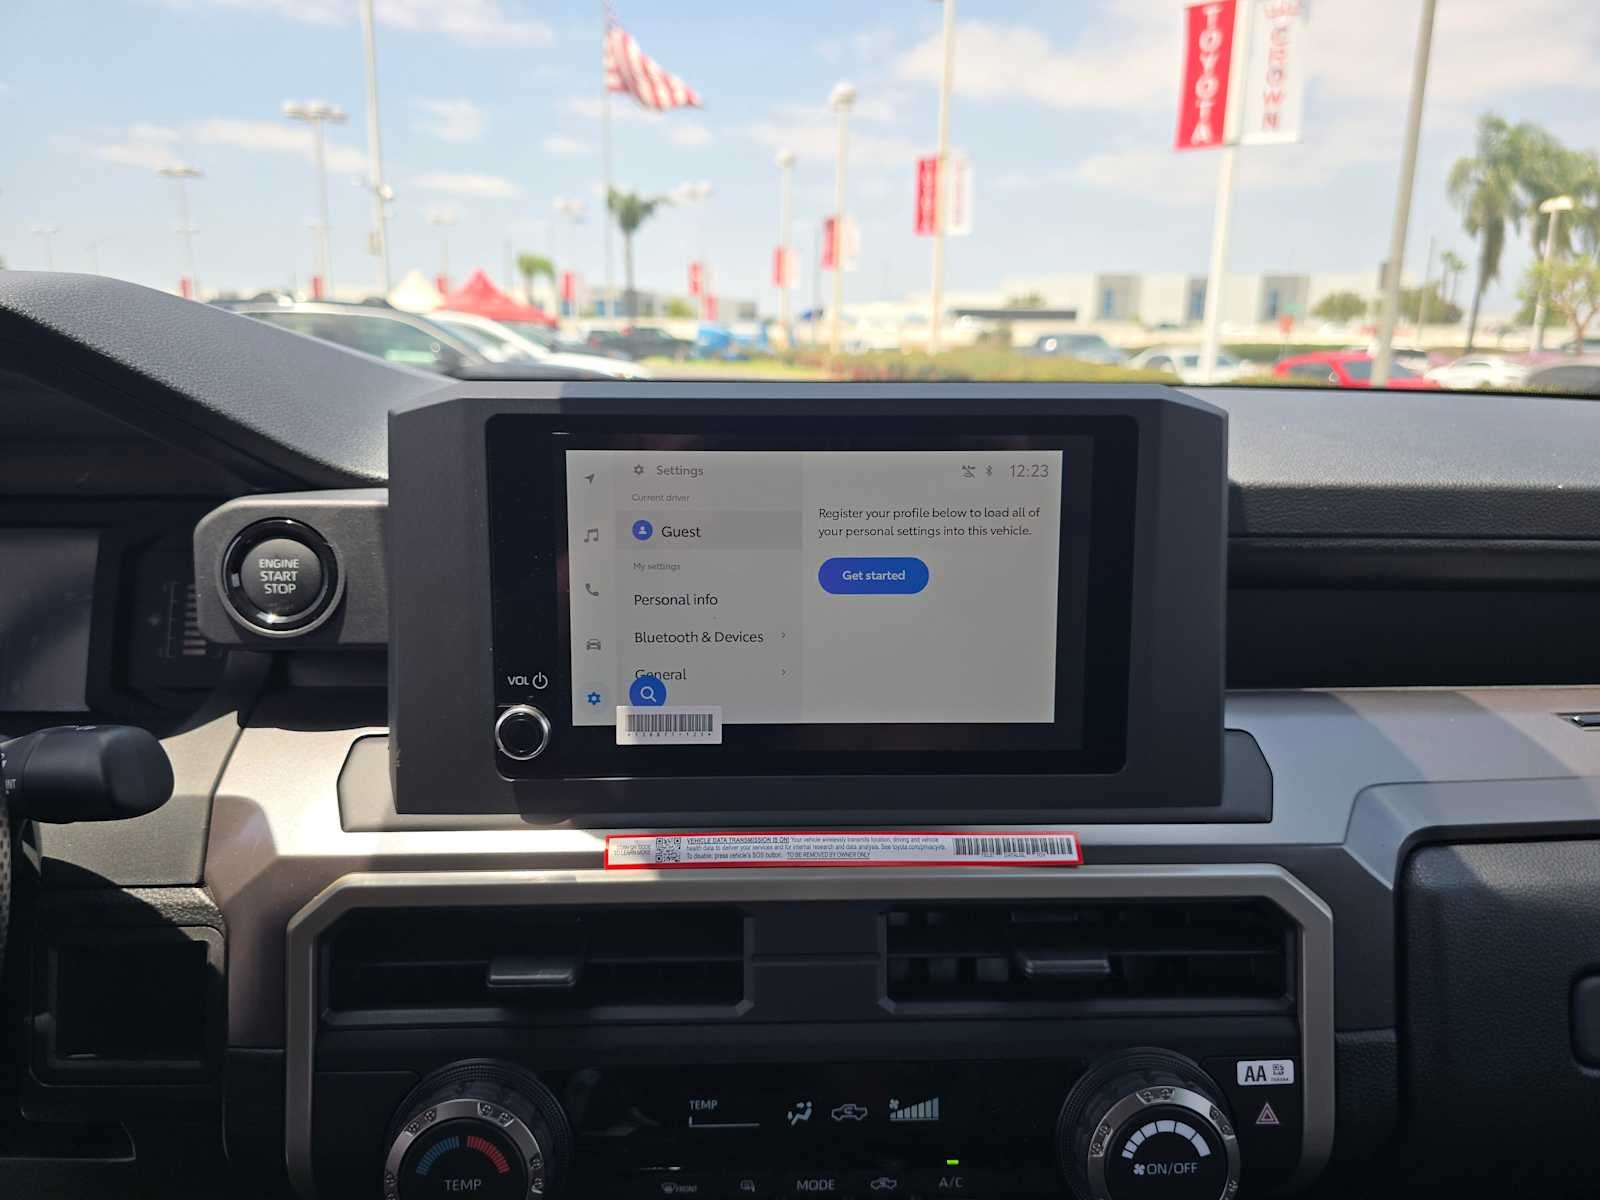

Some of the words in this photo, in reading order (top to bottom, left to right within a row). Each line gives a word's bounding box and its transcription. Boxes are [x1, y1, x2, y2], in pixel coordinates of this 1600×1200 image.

[1190, 5, 1222, 144] TOYOTA
[656, 464, 704, 478] Settings
[1009, 464, 1049, 478] 12:23
[632, 493, 664, 502] Current
[666, 493, 690, 502] driver
[819, 507, 863, 519] Register
[866, 509, 891, 519] your
[893, 507, 930, 519] profile
[932, 507, 967, 518] below
[970, 508, 982, 518] to
[984, 507, 1010, 518] load
[1012, 507, 1026, 518] all
[1028, 507, 1041, 518] of
[661, 525, 702, 539] Guest
[818, 526, 844, 538] your
[846, 525, 894, 537] personal
[896, 525, 941, 537] settings
[943, 525, 965, 536] into
[968, 525, 988, 536] this
[990, 525, 1032, 536] vehicle.
[258, 558, 300, 569] ENGINE
[633, 562, 645, 572] My
[647, 562, 681, 571] settings
[260, 570, 298, 582] START
[842, 570, 863, 581] Get
[865, 569, 906, 581] started
[264, 583, 297, 595] STOP
[633, 593, 690, 606] Personal
[693, 593, 718, 606] info
[634, 630, 698, 643] Bluetooth
[701, 631, 712, 643] &
[714, 630, 764, 643] Devices
[507, 675, 529, 686] VOL
[1244, 1065, 1267, 1082] AA
[689, 1100, 718, 1111] TEMP
[1147, 1163, 1198, 1175] ON/OFF
[444, 1179, 482, 1191] TEMP
[796, 1179, 836, 1191] MODE
[939, 1176, 964, 1188] A/C
